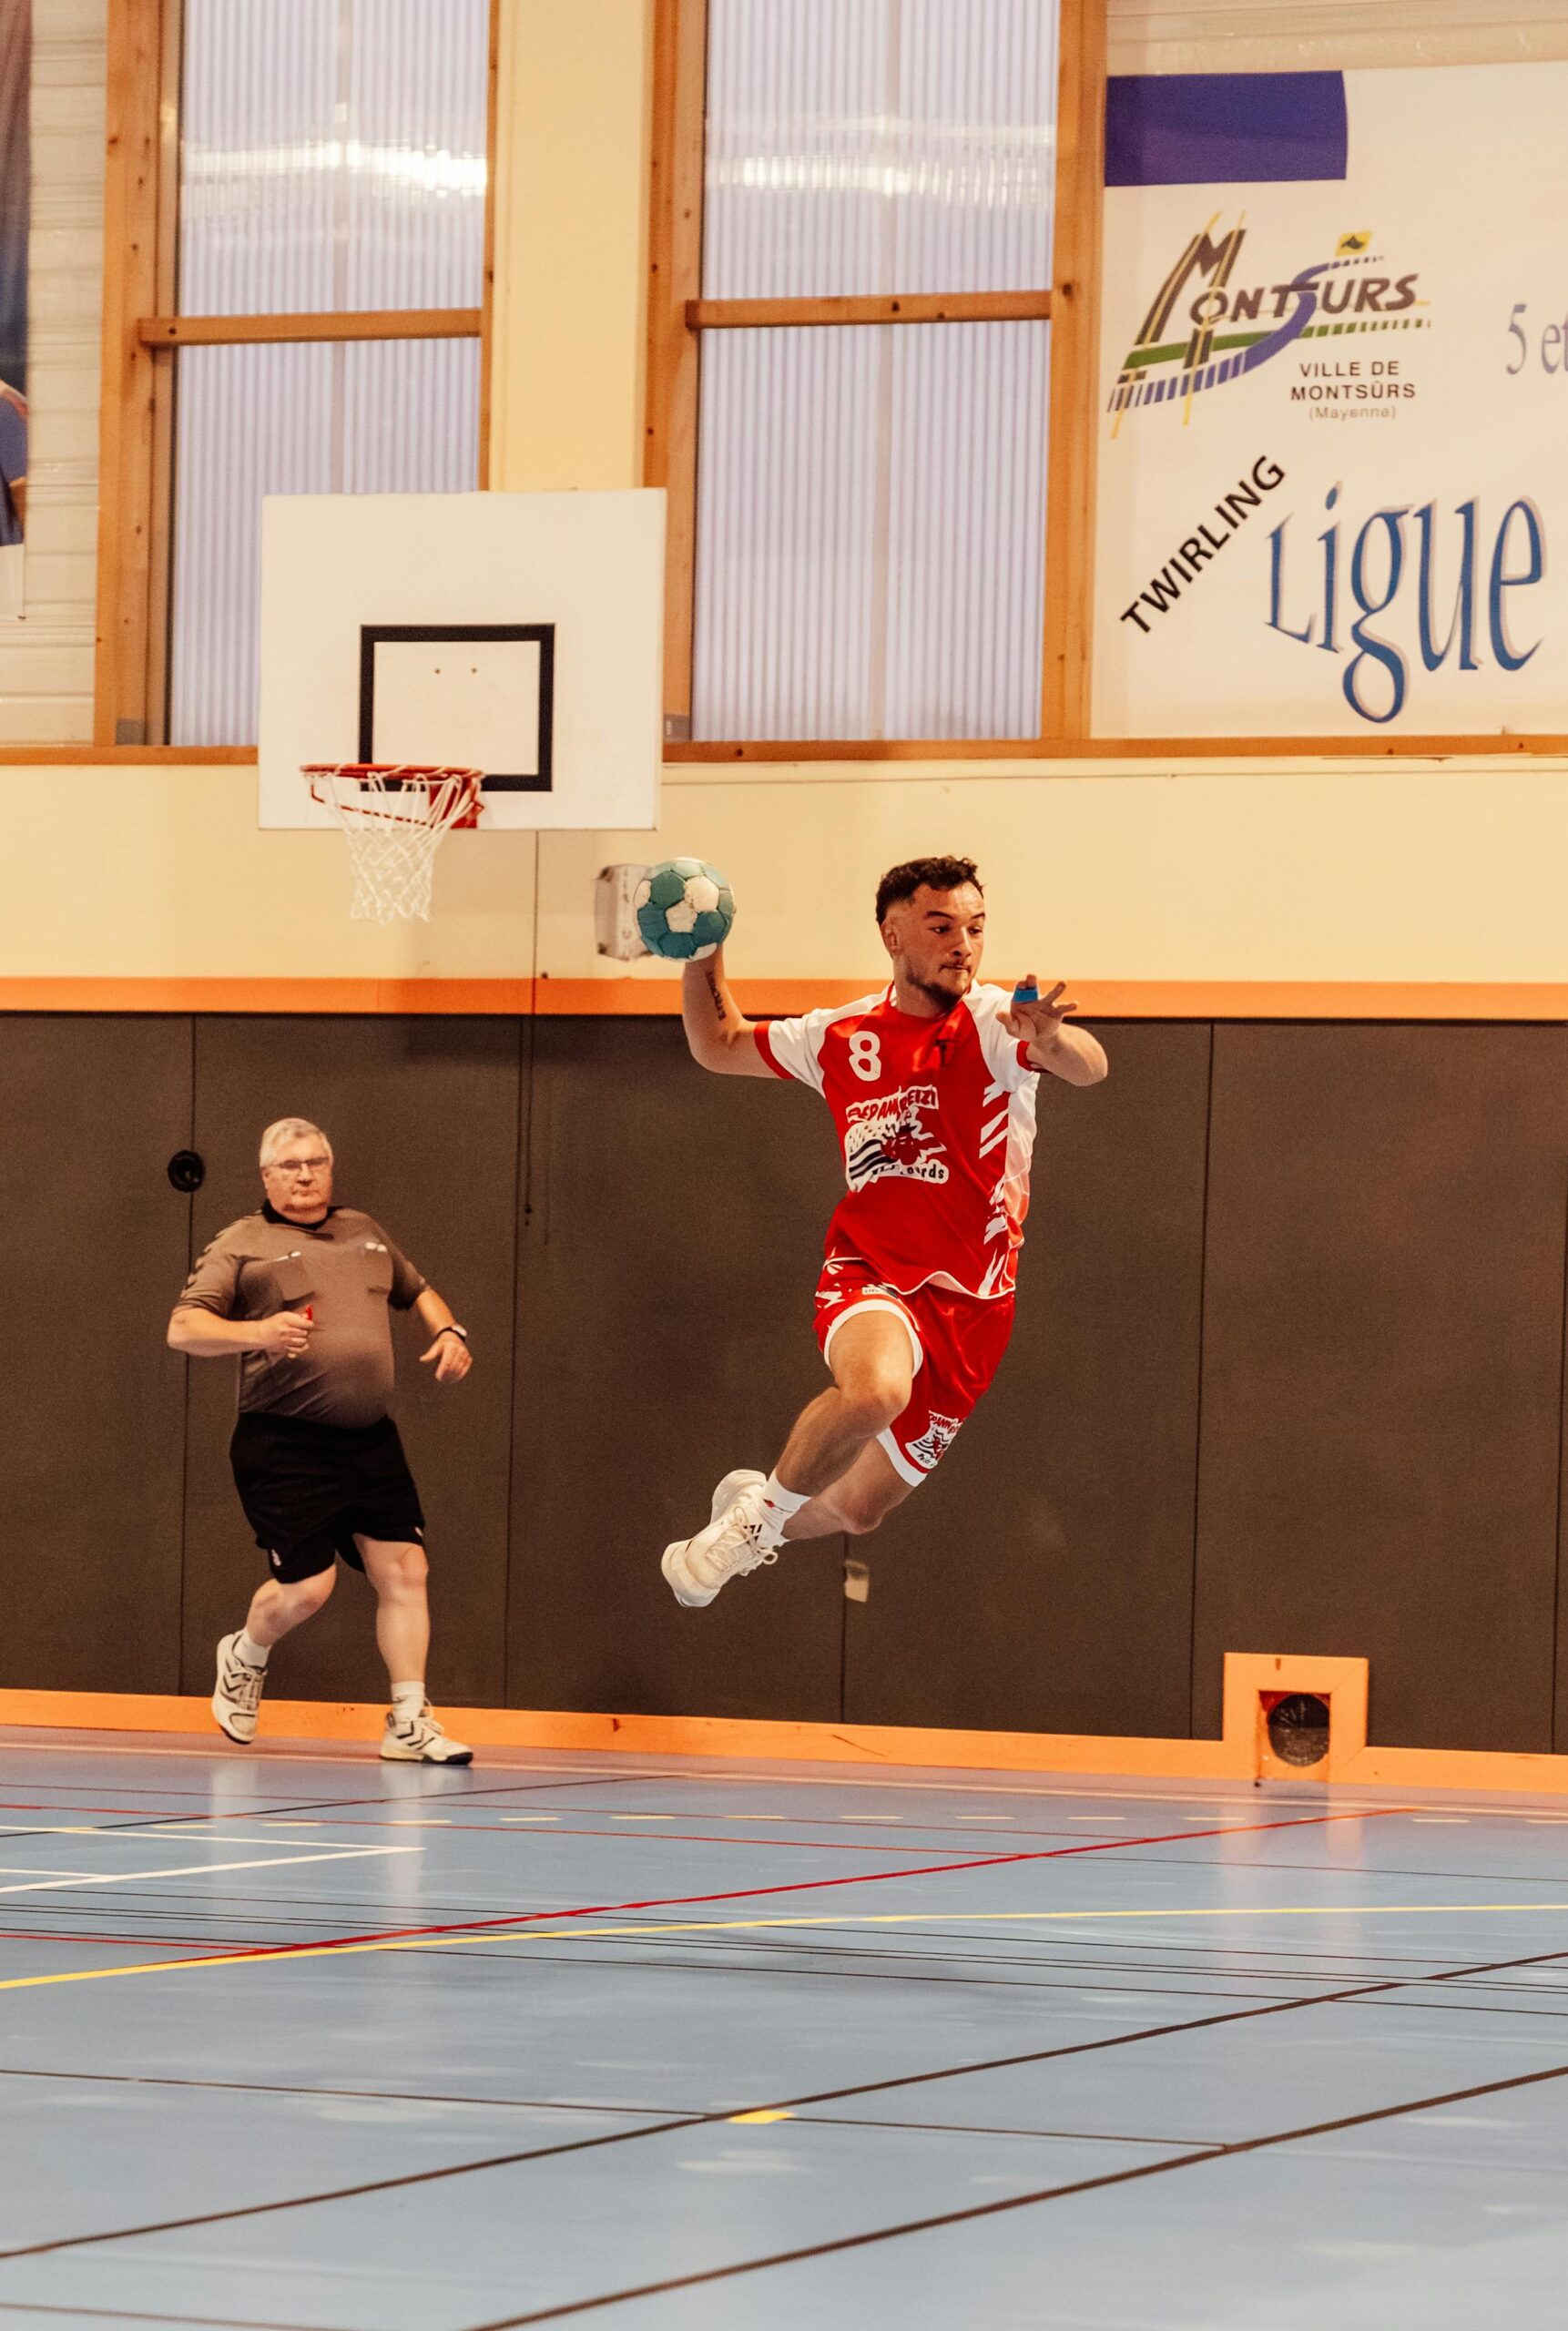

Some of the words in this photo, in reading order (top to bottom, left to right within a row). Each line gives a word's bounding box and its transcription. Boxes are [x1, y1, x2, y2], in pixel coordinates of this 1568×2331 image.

[1505, 302, 1527, 375] 5
[1290, 380, 1417, 402] MONTSÛRS
[1299, 361, 1361, 378] VILLE
[1371, 361, 1400, 376] DE
[1308, 405, 1397, 422] (Mayenne)
[1120, 454, 1286, 635] TWIRLING
[1264, 480, 1548, 724] Ligue
[848, 1030, 882, 1082] 8
